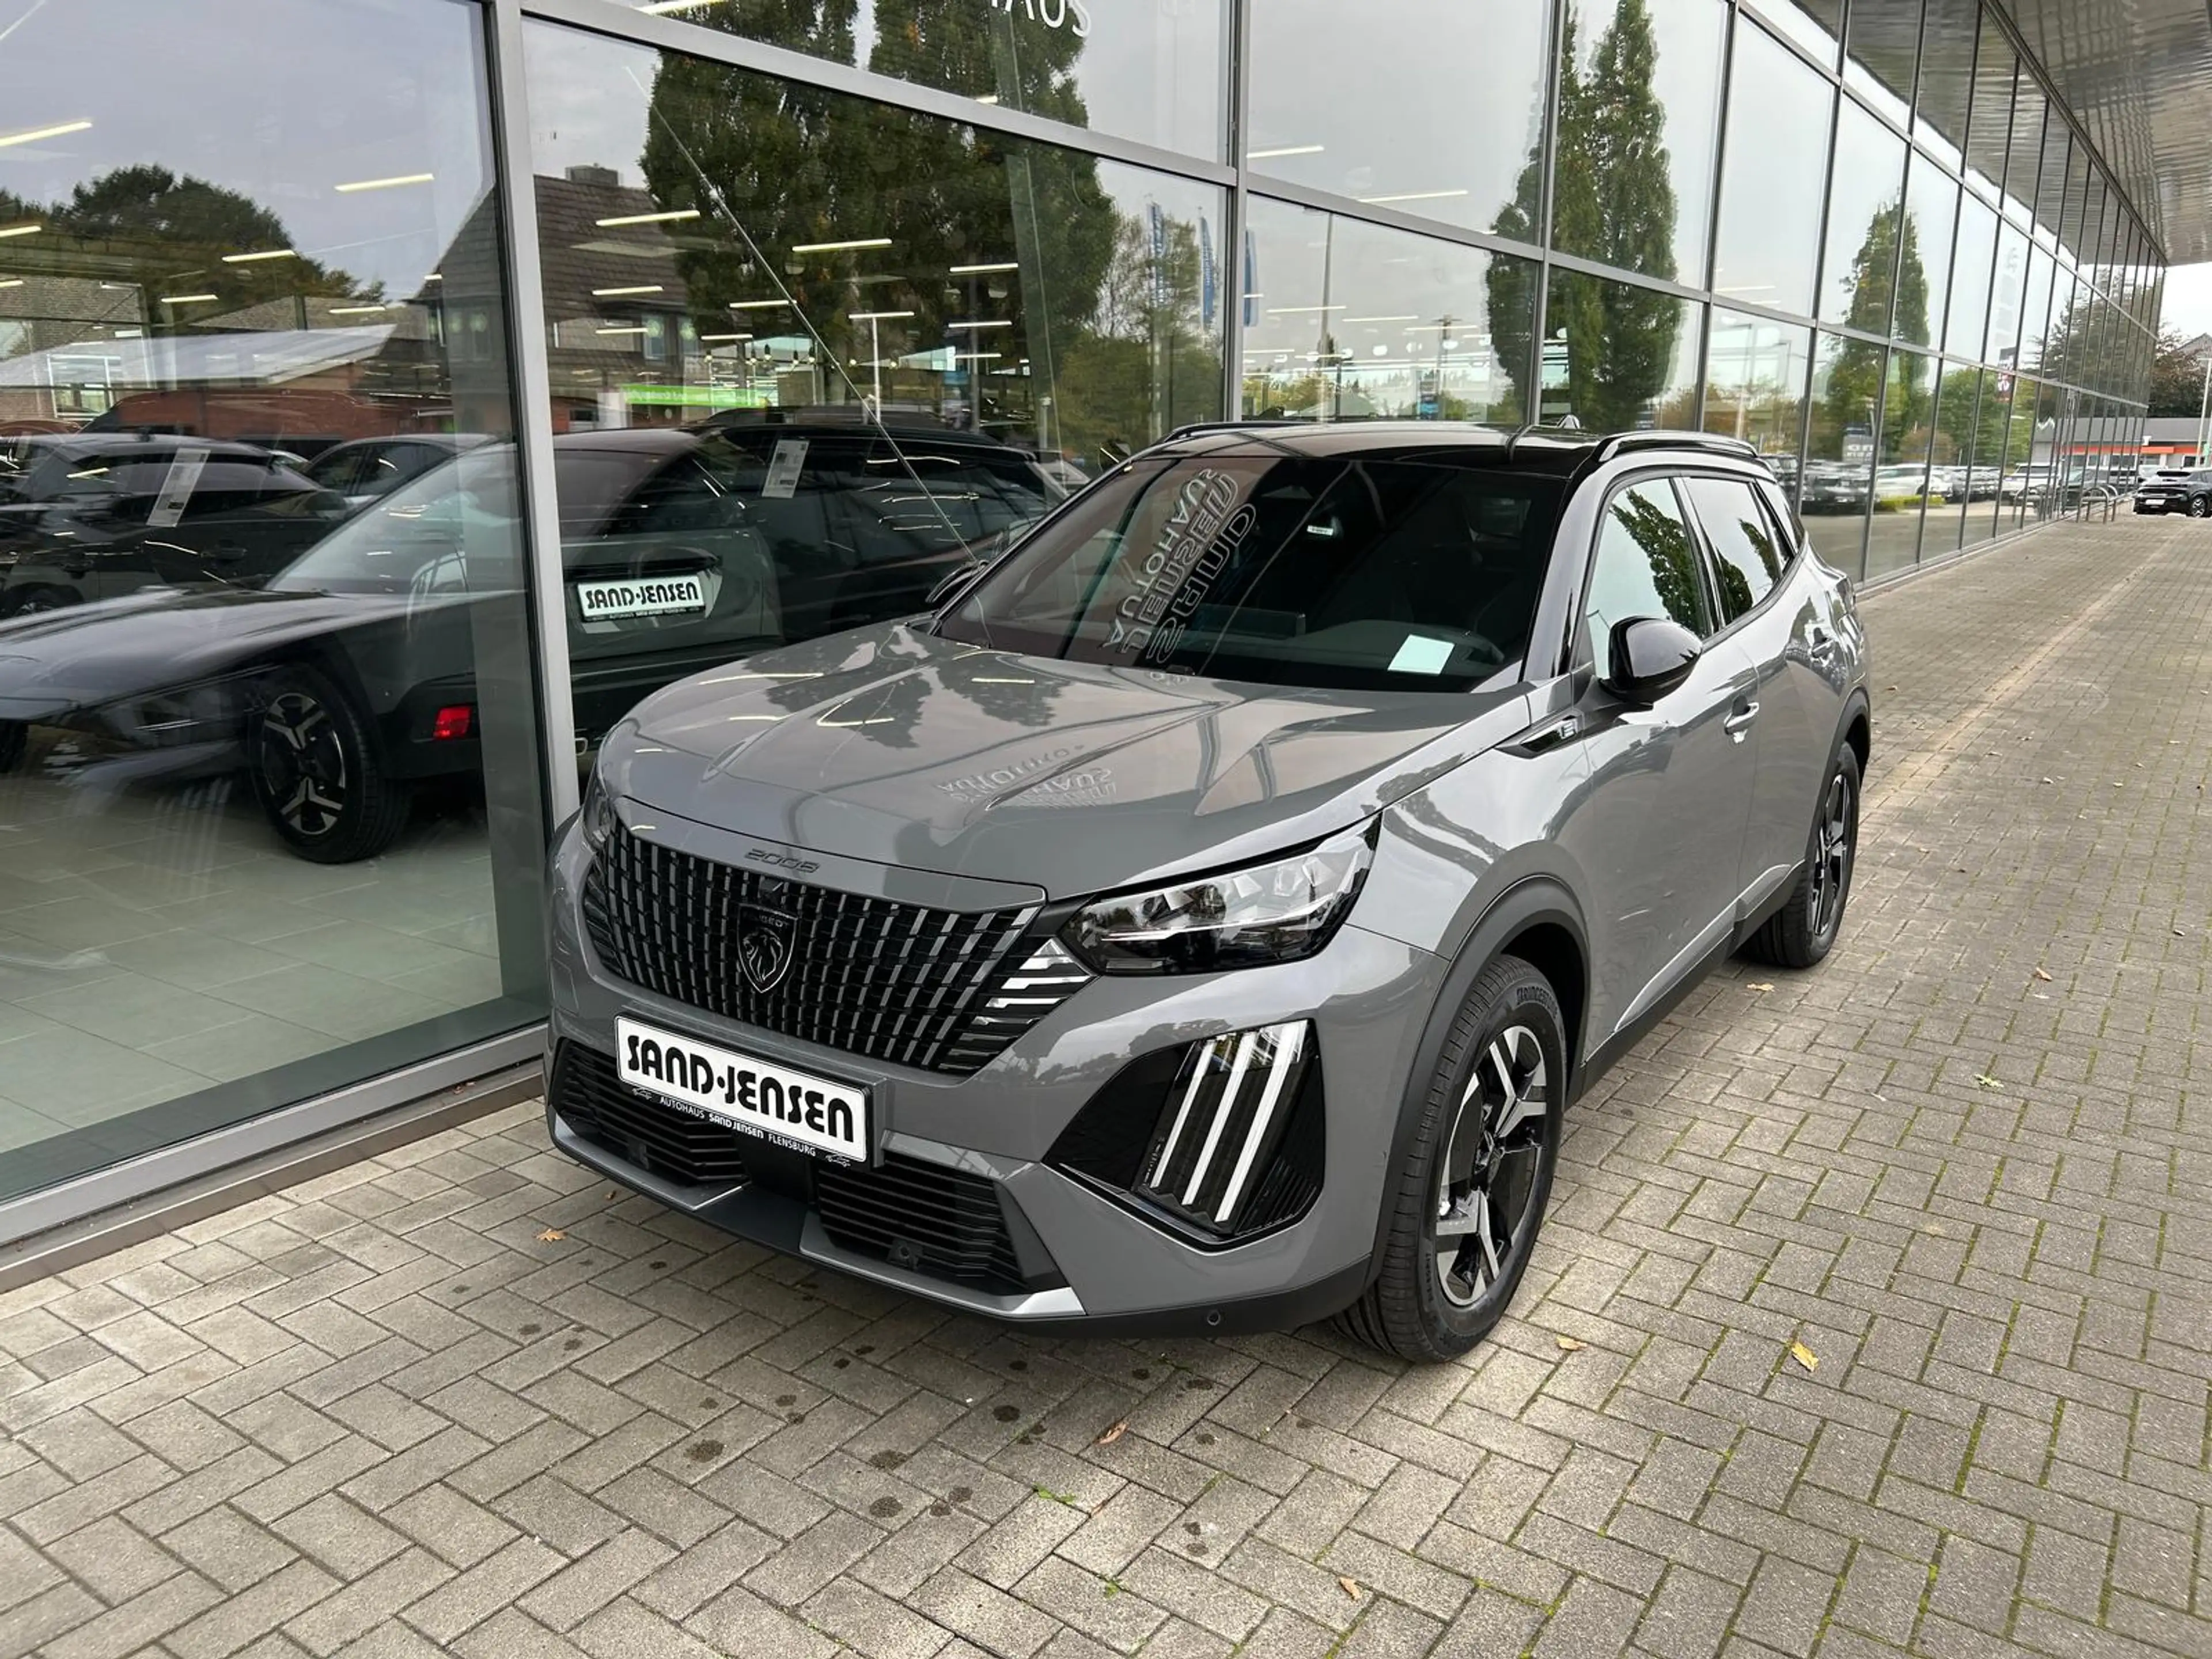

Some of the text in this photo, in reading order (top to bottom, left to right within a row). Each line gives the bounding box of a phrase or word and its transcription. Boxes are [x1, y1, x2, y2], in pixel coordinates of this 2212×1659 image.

[744, 848, 821, 873] 2008
[659, 1096, 705, 1119] AUTOHAUS
[768, 1132, 816, 1157] FLENSBURG
